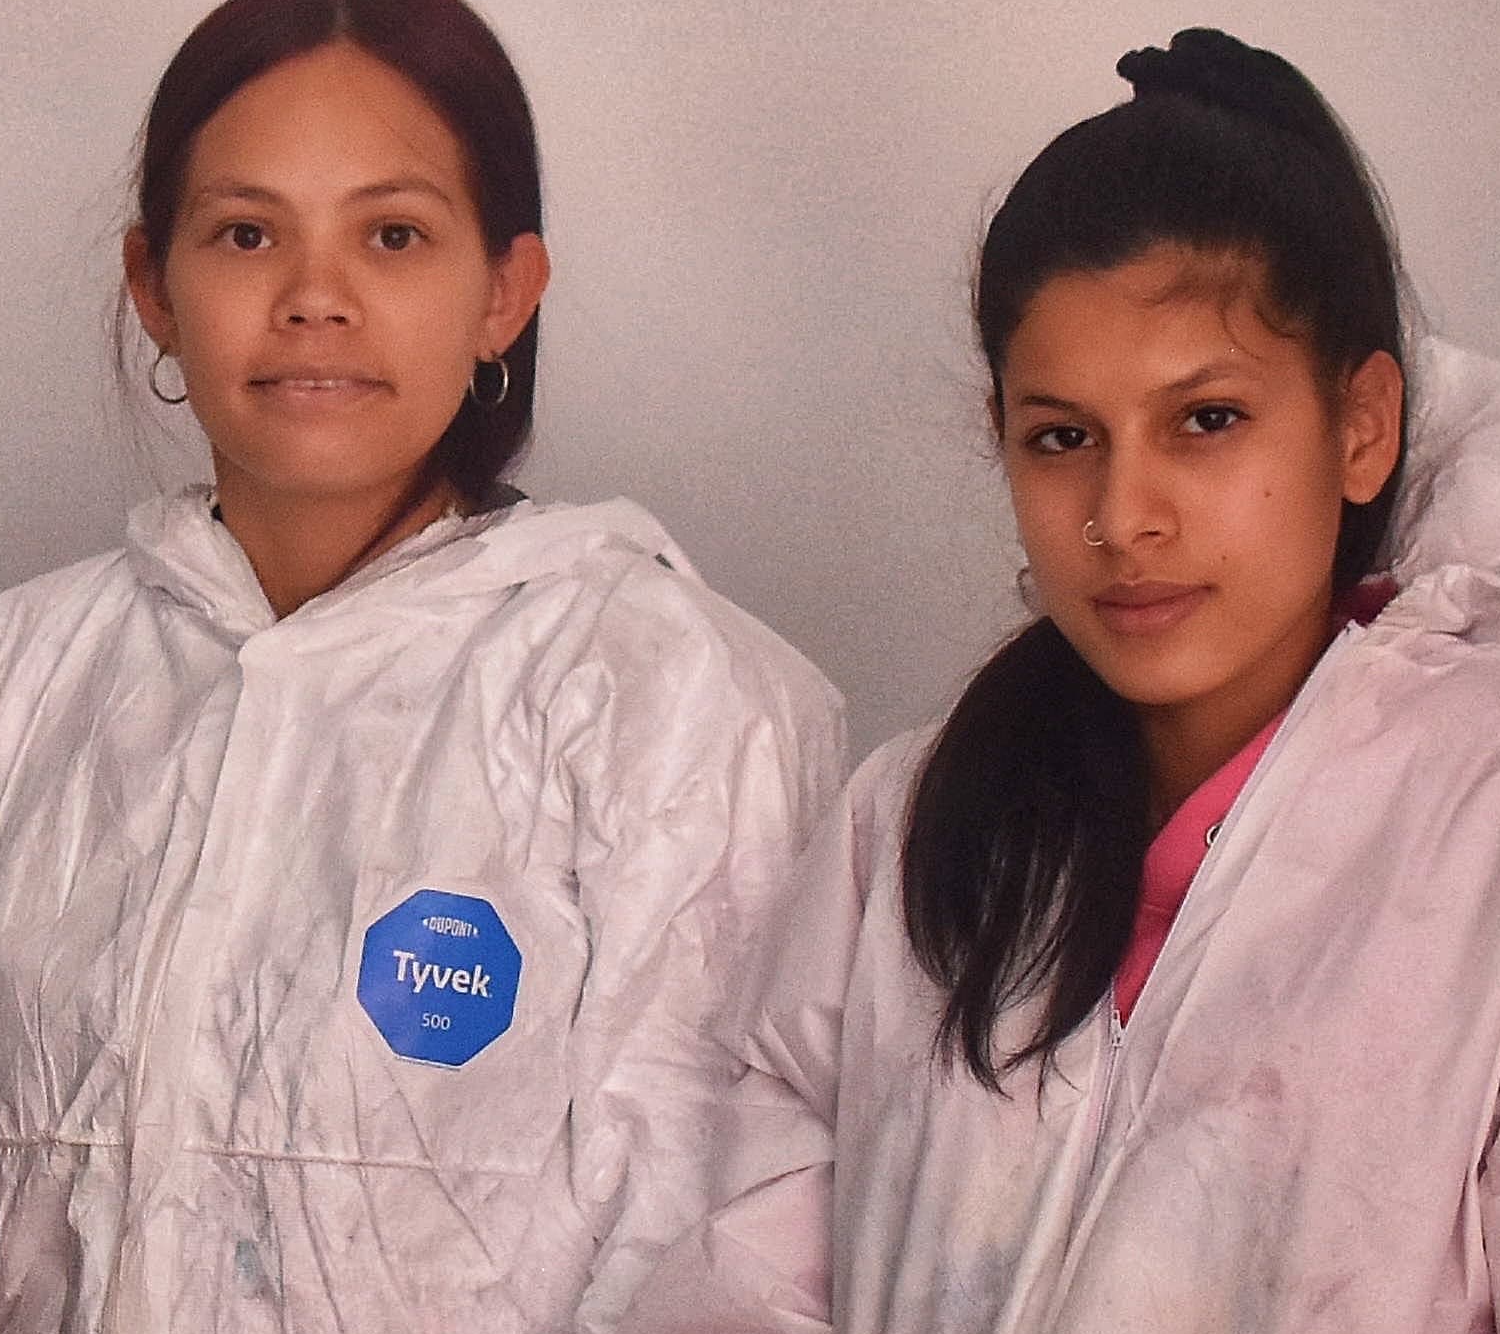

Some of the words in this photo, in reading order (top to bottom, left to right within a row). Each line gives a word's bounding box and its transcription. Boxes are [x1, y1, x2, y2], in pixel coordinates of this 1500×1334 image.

[429, 916, 473, 938] DUPONT
[392, 950, 490, 998] Tyvek
[421, 1013, 451, 1031] 500
